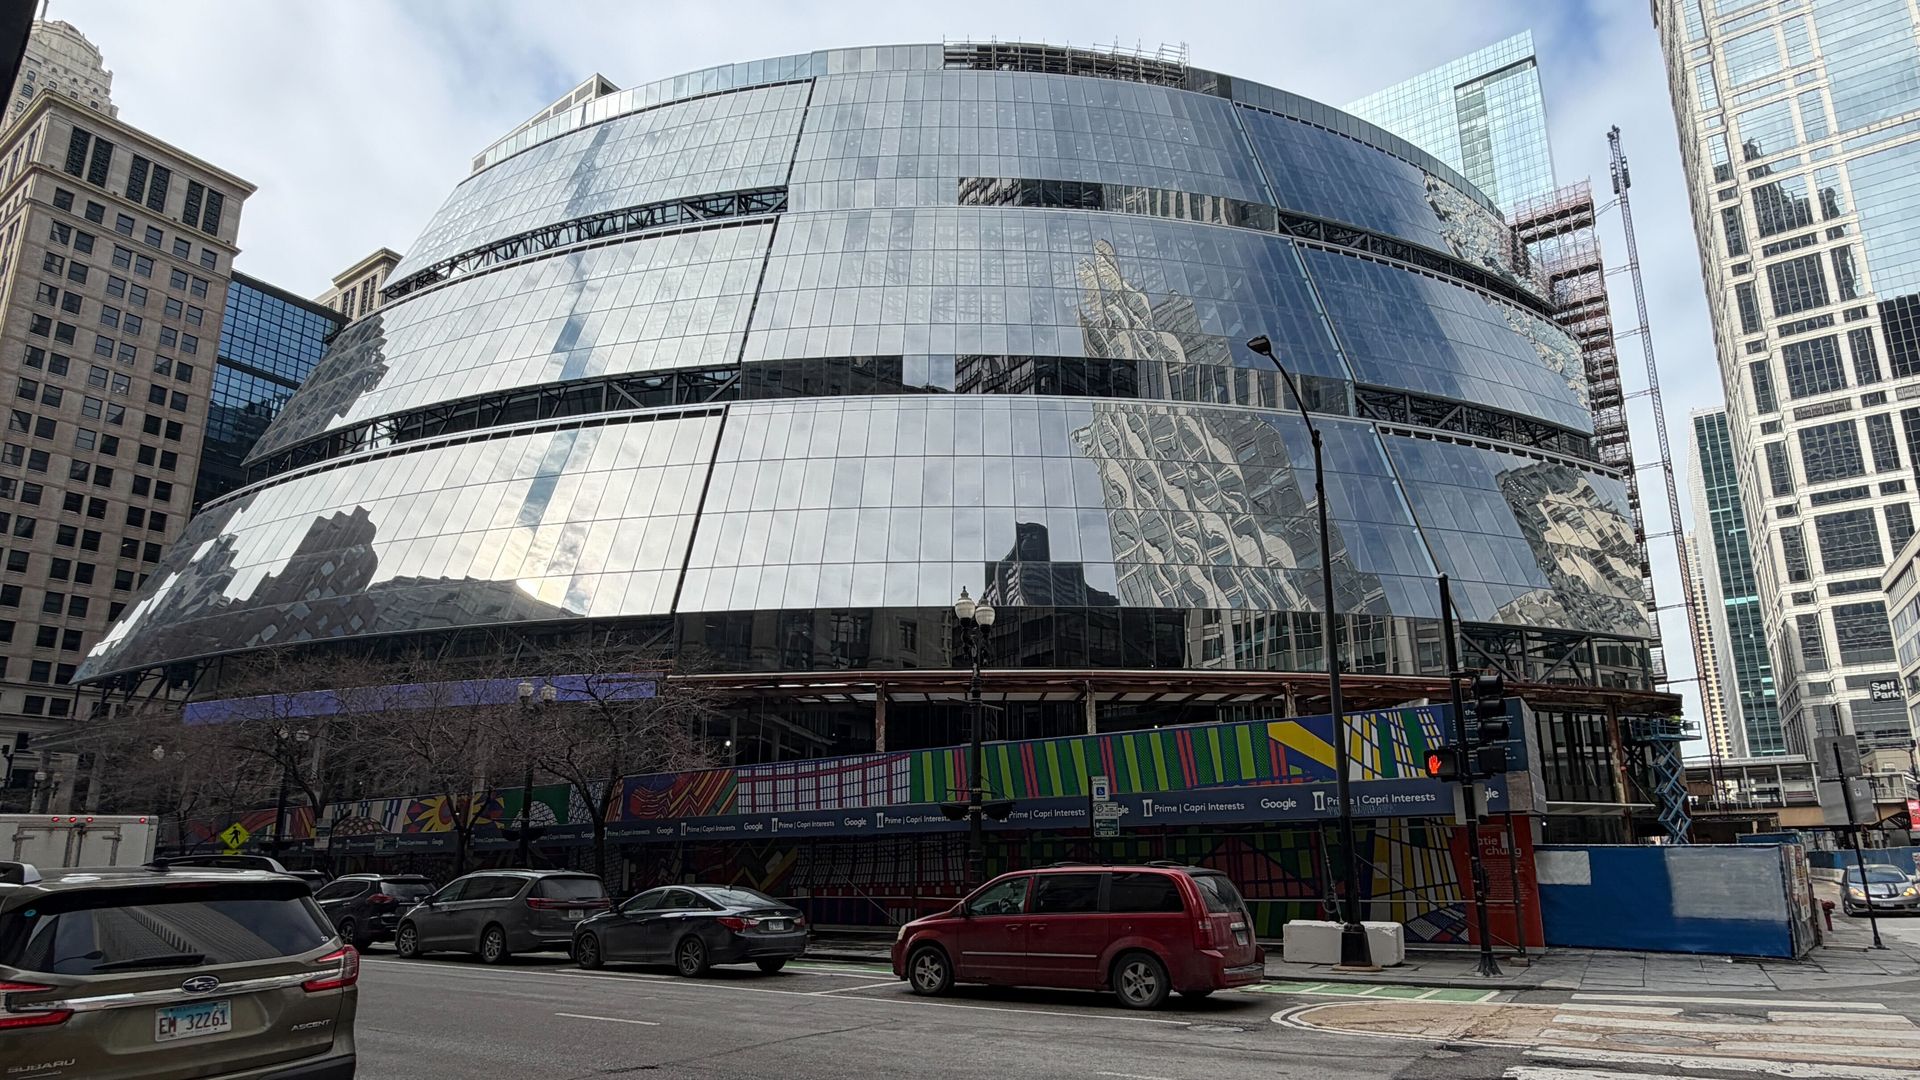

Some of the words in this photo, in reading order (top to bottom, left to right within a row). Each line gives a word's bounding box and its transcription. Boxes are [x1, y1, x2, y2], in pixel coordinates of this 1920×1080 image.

[1871, 681, 1895, 691] Self
[1873, 690, 1900, 699] Park
[1260, 797, 1297, 811] Google
[1326, 796, 1354, 806] Prie
[1361, 794, 1389, 806] Capri
[1391, 793, 1436, 804] Interests
[1008, 809, 1029, 819] Prime
[1033, 809, 1053, 819] Capri
[1054, 808, 1086, 818] Interests
[1154, 803, 1177, 813] Prime
[1183, 802, 1206, 814] Capri
[1208, 802, 1245, 811] Interests
[778, 821, 793, 830] Prime
[796, 820, 811, 830] Capri
[811, 819, 836, 828] Interests
[843, 817, 868, 828] Google
[884, 816, 902, 825] Prime
[905, 816, 923, 825] Capri
[656, 826, 674, 836] Google
[743, 821, 764, 832] Google
[1478, 835, 1498, 846] atie
[159, 1016, 177, 1035] EM
[186, 1009, 228, 1031] 32261
[290, 1018, 332, 1032] ASCENT
[7, 1058, 76, 1074] SUBARU
